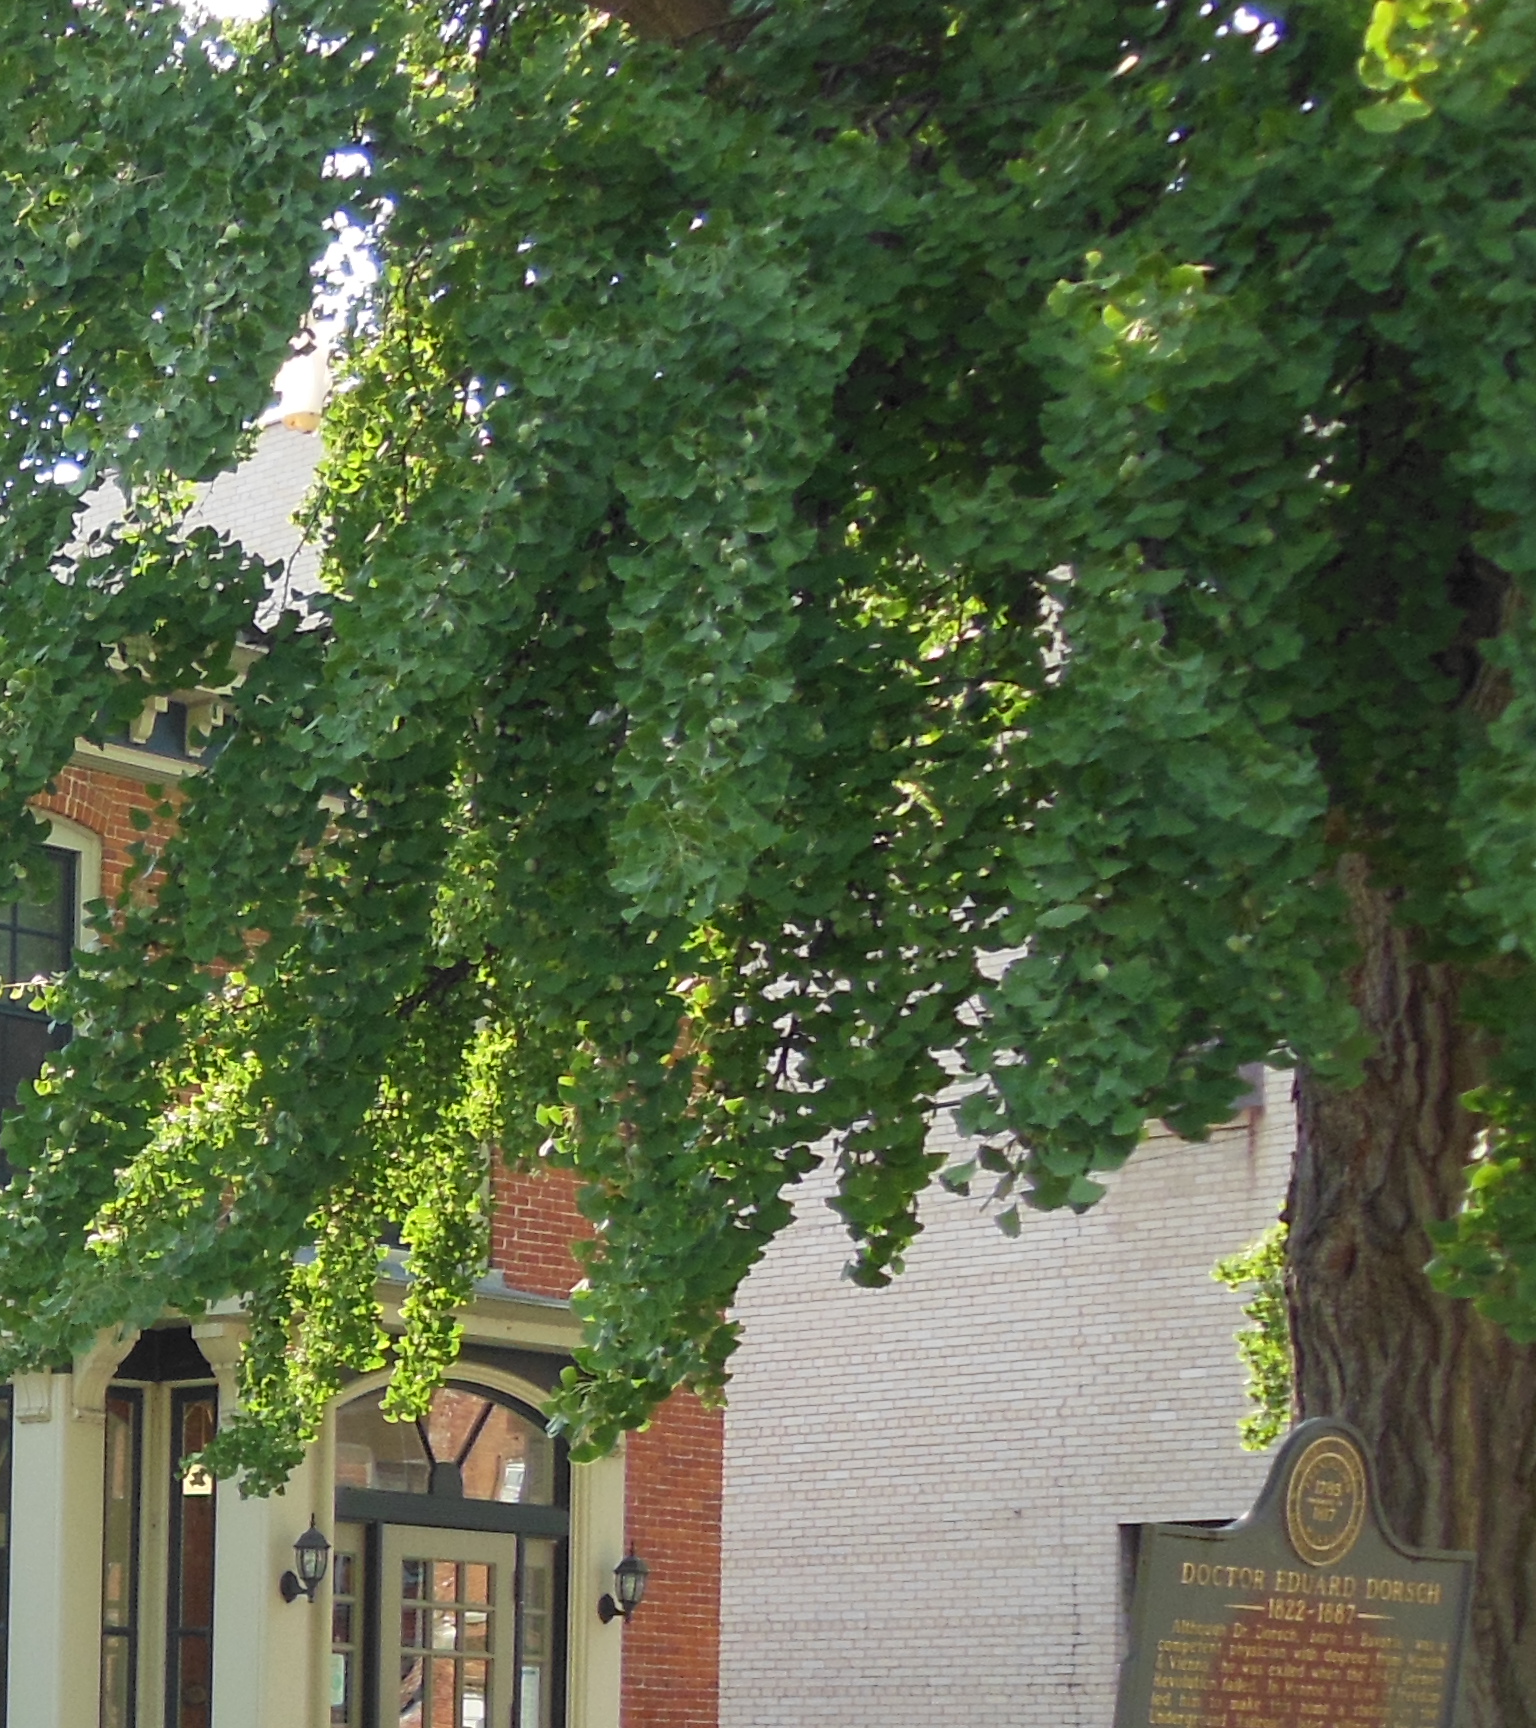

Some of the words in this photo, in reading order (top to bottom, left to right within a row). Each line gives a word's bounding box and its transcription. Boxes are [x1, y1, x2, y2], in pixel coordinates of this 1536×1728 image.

[1182, 1561, 1265, 1590] DOCTOR
[1276, 1569, 1357, 1597] EDUARD
[1367, 1577, 1441, 1604] DORSCH
[1268, 1599, 1356, 1625] 1822-1887
